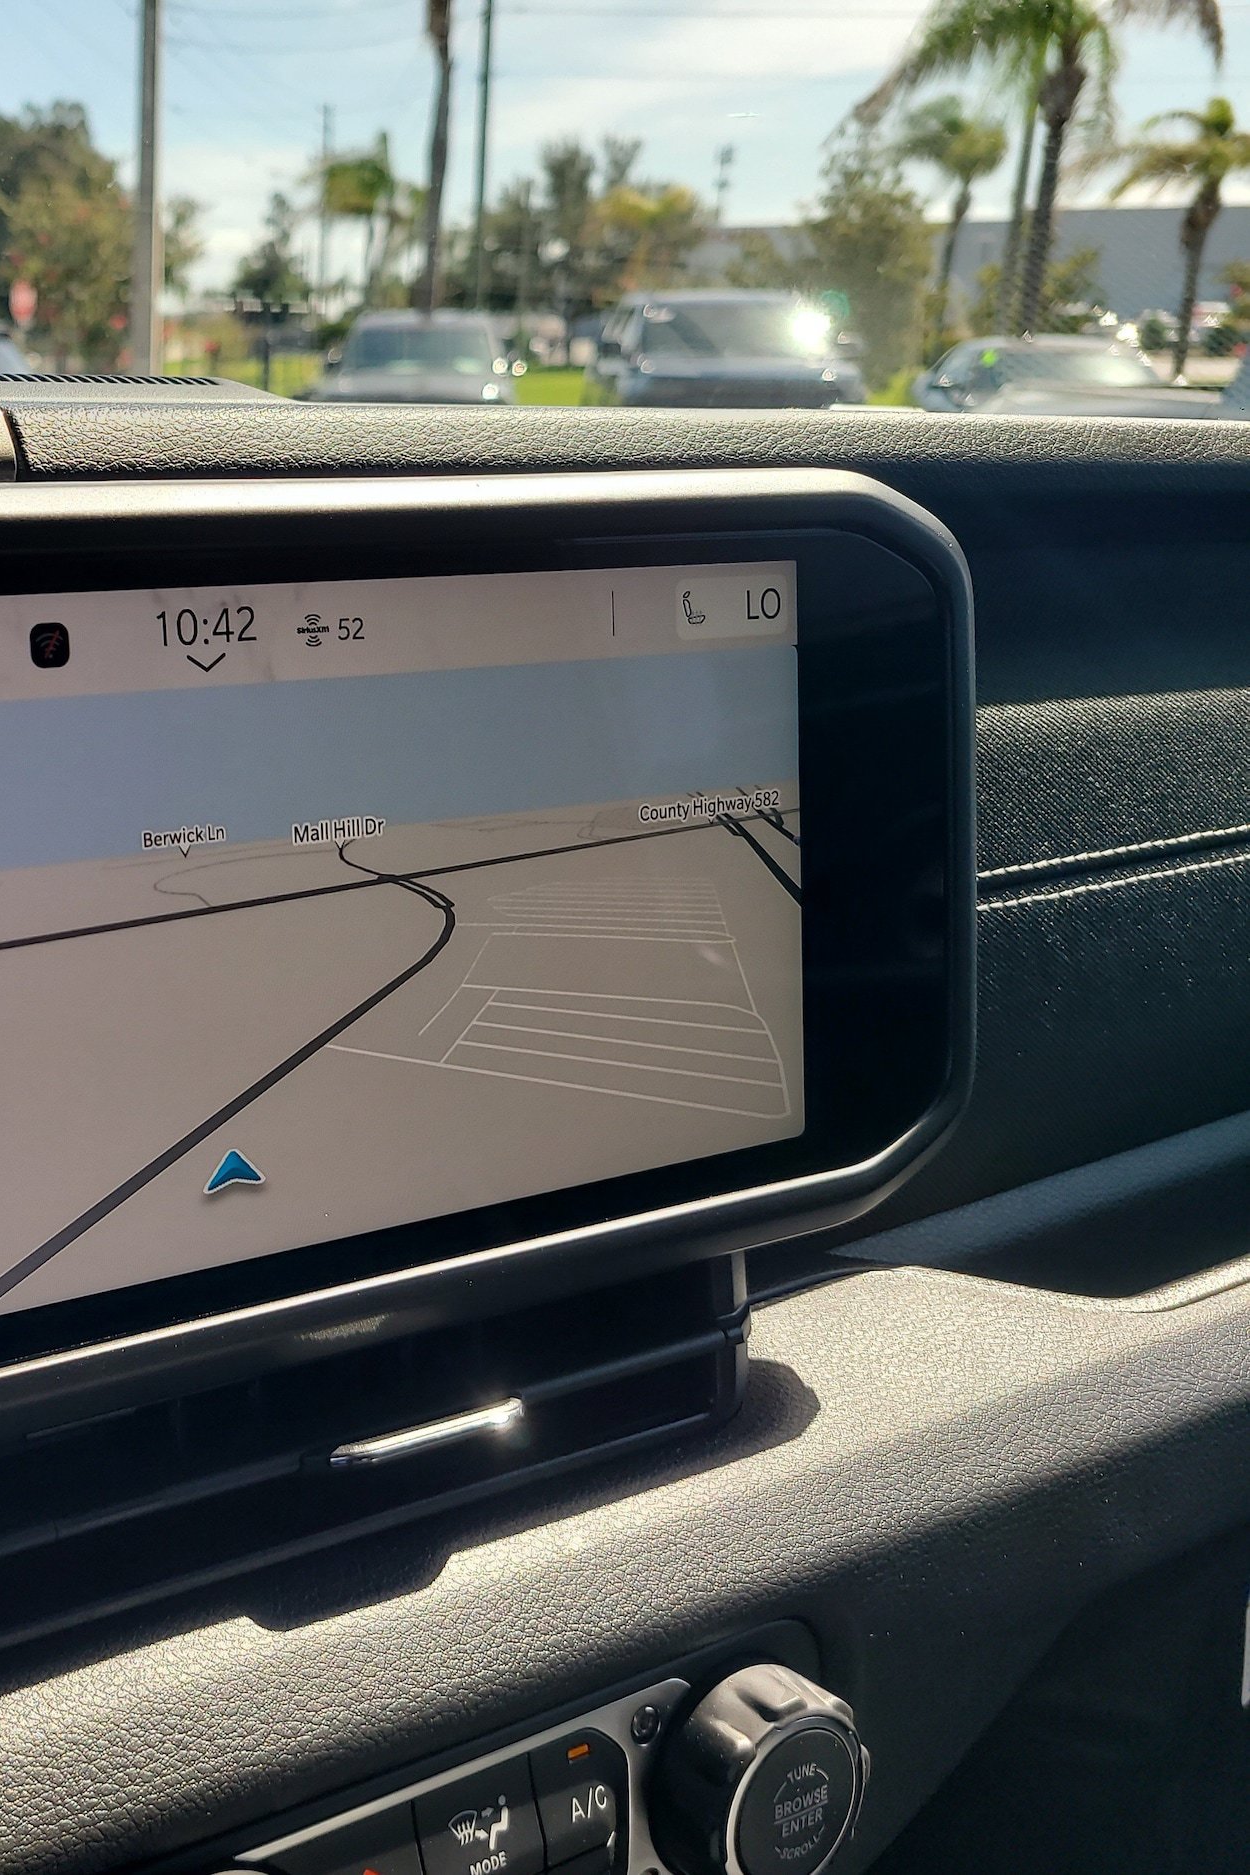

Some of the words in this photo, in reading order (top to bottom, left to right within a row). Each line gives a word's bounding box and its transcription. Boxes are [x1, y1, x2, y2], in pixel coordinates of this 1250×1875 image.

[746, 587, 781, 621] LO
[156, 606, 257, 646] 10:42
[337, 617, 365, 640] 52
[640, 802, 689, 821] County
[693, 796, 751, 817] Highway
[754, 790, 779, 808] 582
[143, 826, 204, 848] Berwick
[207, 826, 225, 841] Ln
[293, 821, 329, 843] Mall
[332, 818, 361, 840] Hill
[365, 818, 386, 836] Dr
[787, 1763, 817, 1783] TUNE
[571, 1784, 608, 1823] A/C
[774, 1784, 828, 1820] BROWSE
[782, 1806, 823, 1838] ENTER
[780, 1834, 821, 1859] SCROLL
[469, 1850, 508, 1875] MODE
